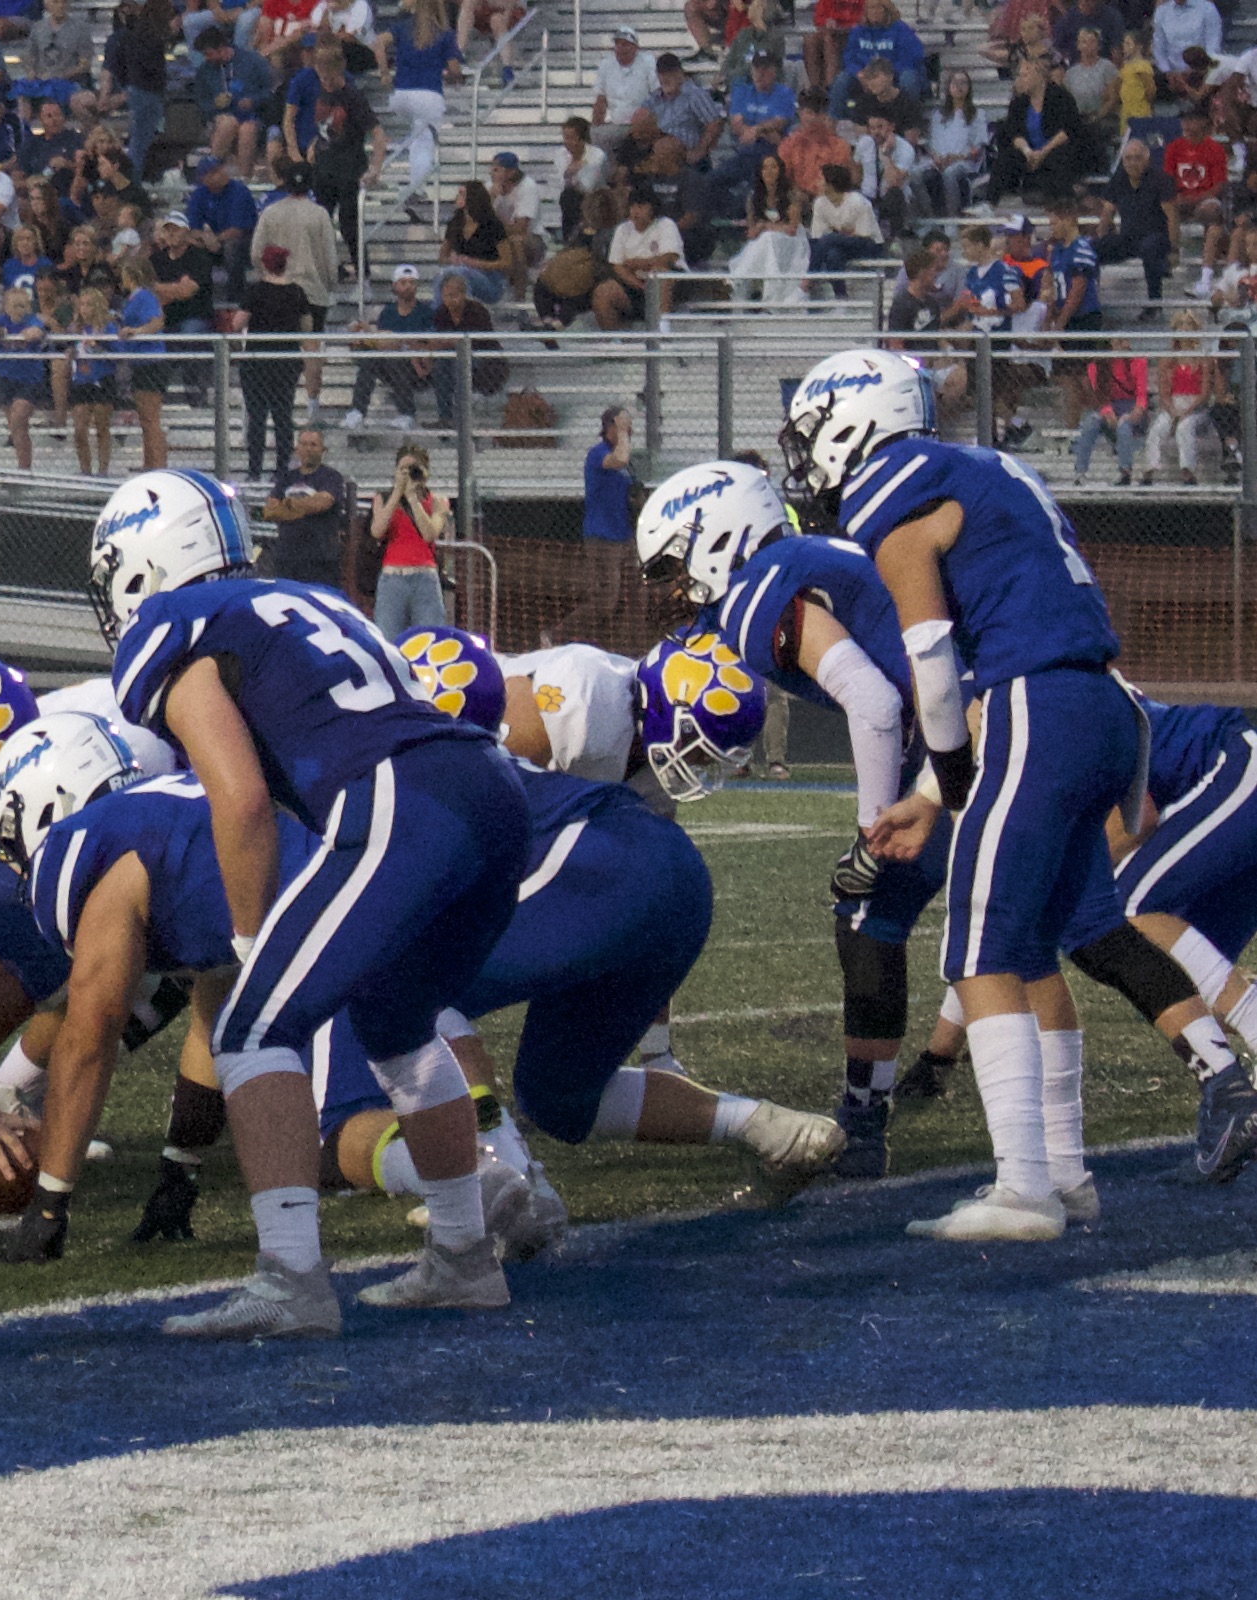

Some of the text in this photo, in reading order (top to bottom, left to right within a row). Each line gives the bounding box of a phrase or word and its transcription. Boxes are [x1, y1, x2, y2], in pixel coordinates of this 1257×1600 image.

[805, 372, 883, 402] Vikings
[661, 476, 734, 520] Vikings
[97, 505, 160, 541] Vikings
